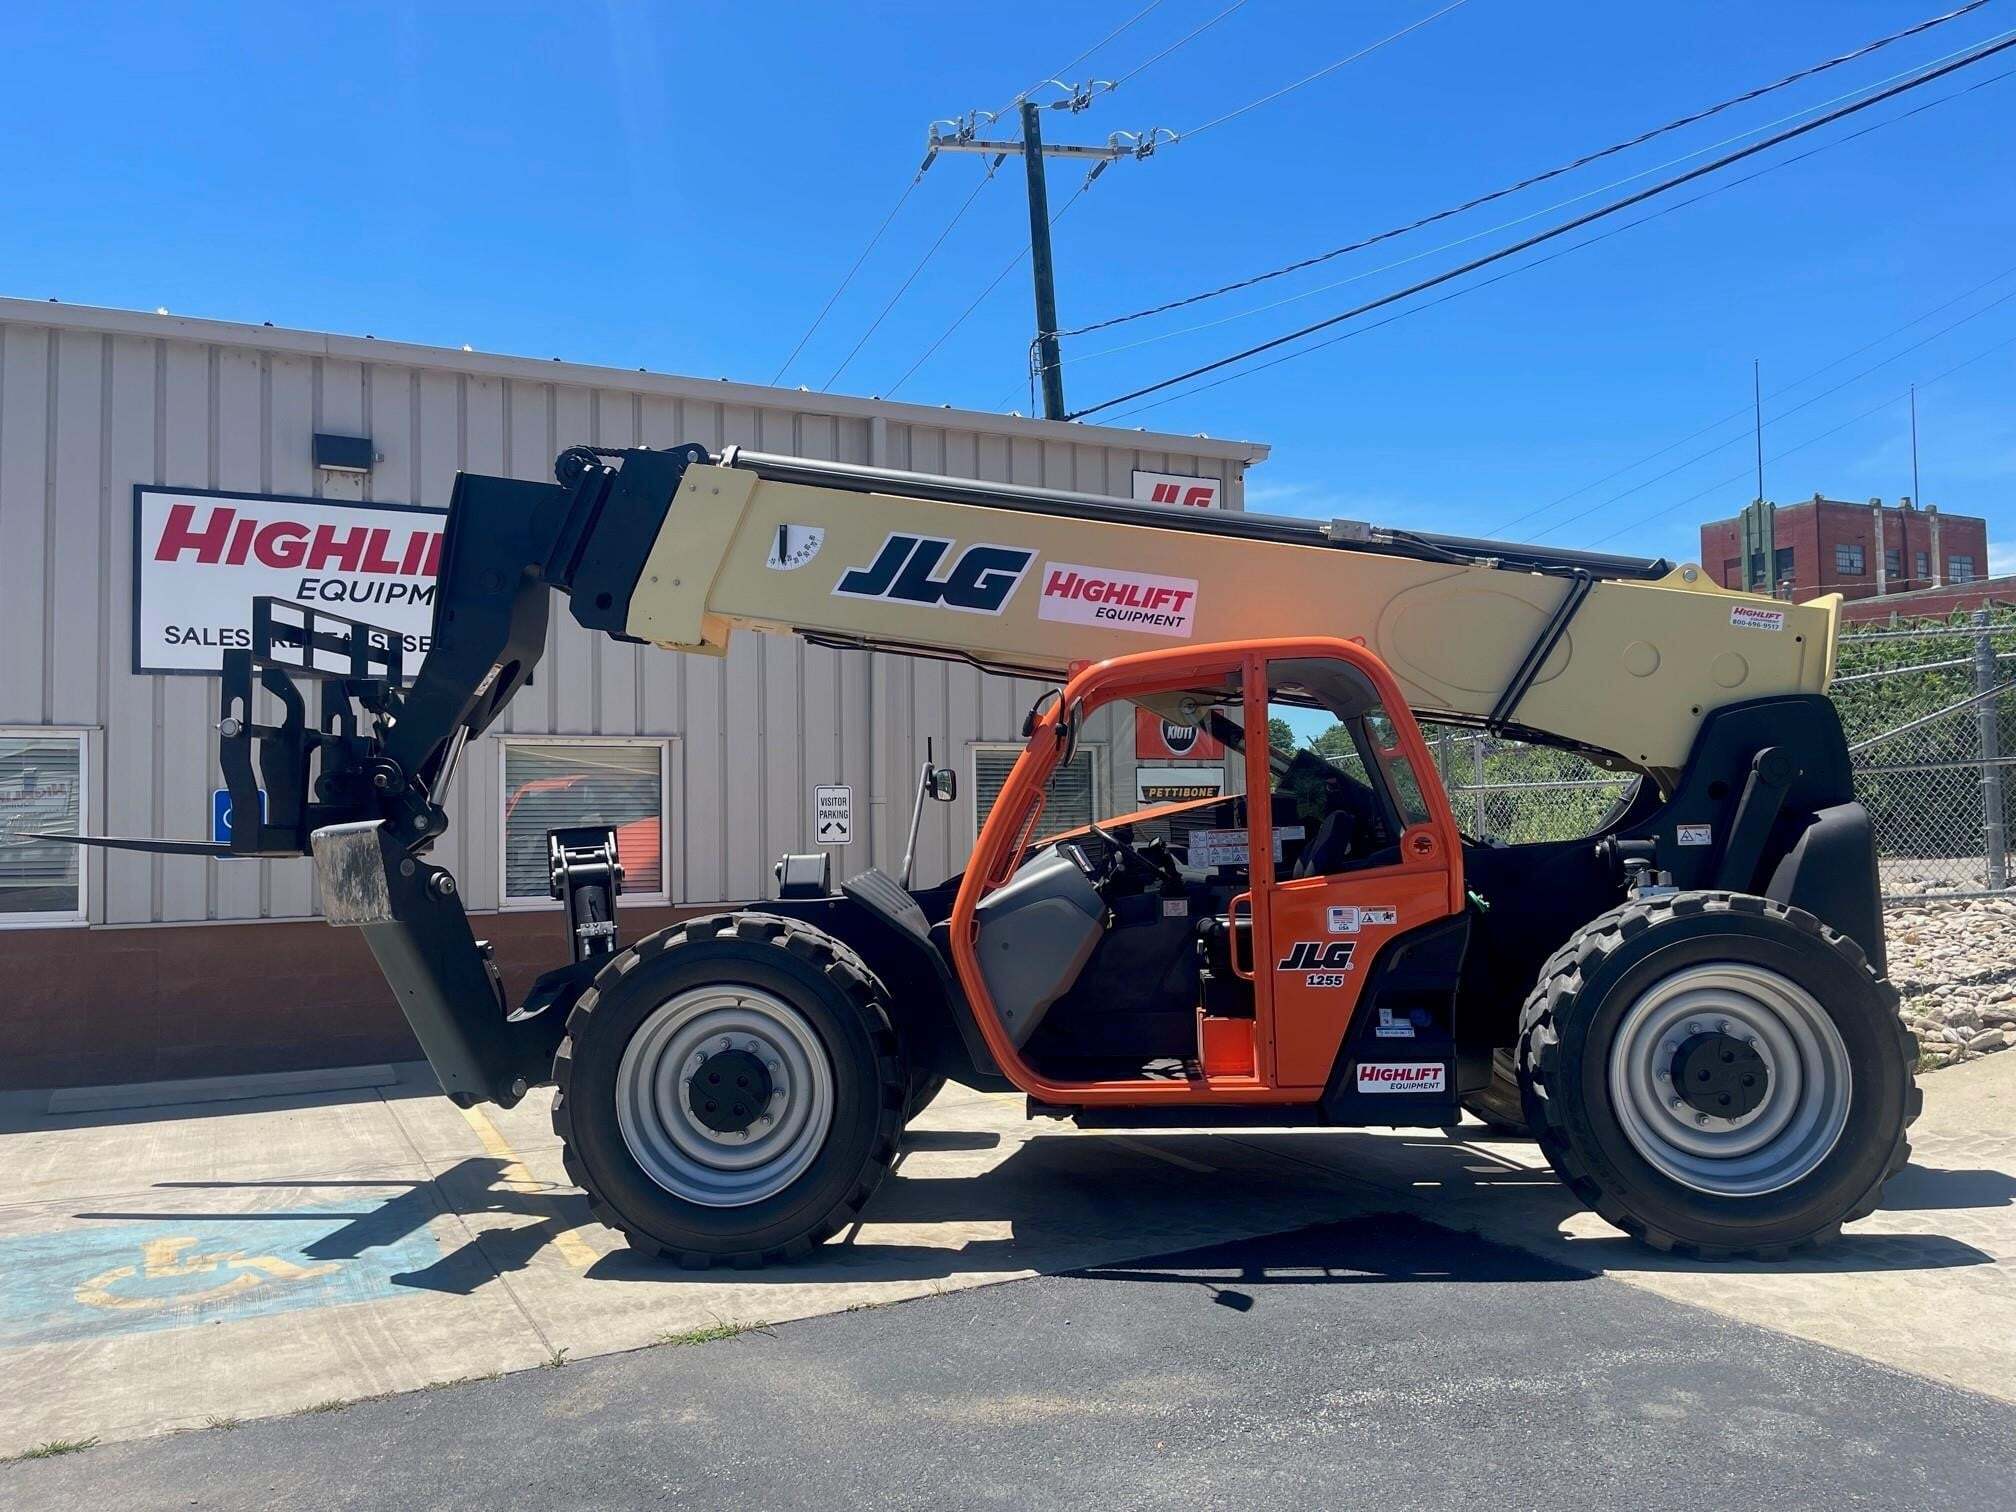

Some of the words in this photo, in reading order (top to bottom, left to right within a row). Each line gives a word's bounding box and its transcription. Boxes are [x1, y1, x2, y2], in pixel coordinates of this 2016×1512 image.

[835, 534, 1034, 612] JLG
[1045, 570, 1194, 612] HIGHLIFT
[1095, 607, 1186, 628] EQUIPMENT
[1733, 607, 1782, 620] HIGHLIFT
[164, 625, 251, 648] SALES
[1148, 787, 1214, 798] PETTIBONE
[820, 797, 847, 807] VISITOR
[819, 810, 849, 820] PARKING
[1278, 942, 1356, 970] JLG
[1307, 974, 1344, 986] 1255
[1360, 1066, 1443, 1082] HIGHLIFT
[1389, 1082, 1441, 1090] EQUIPMENT
